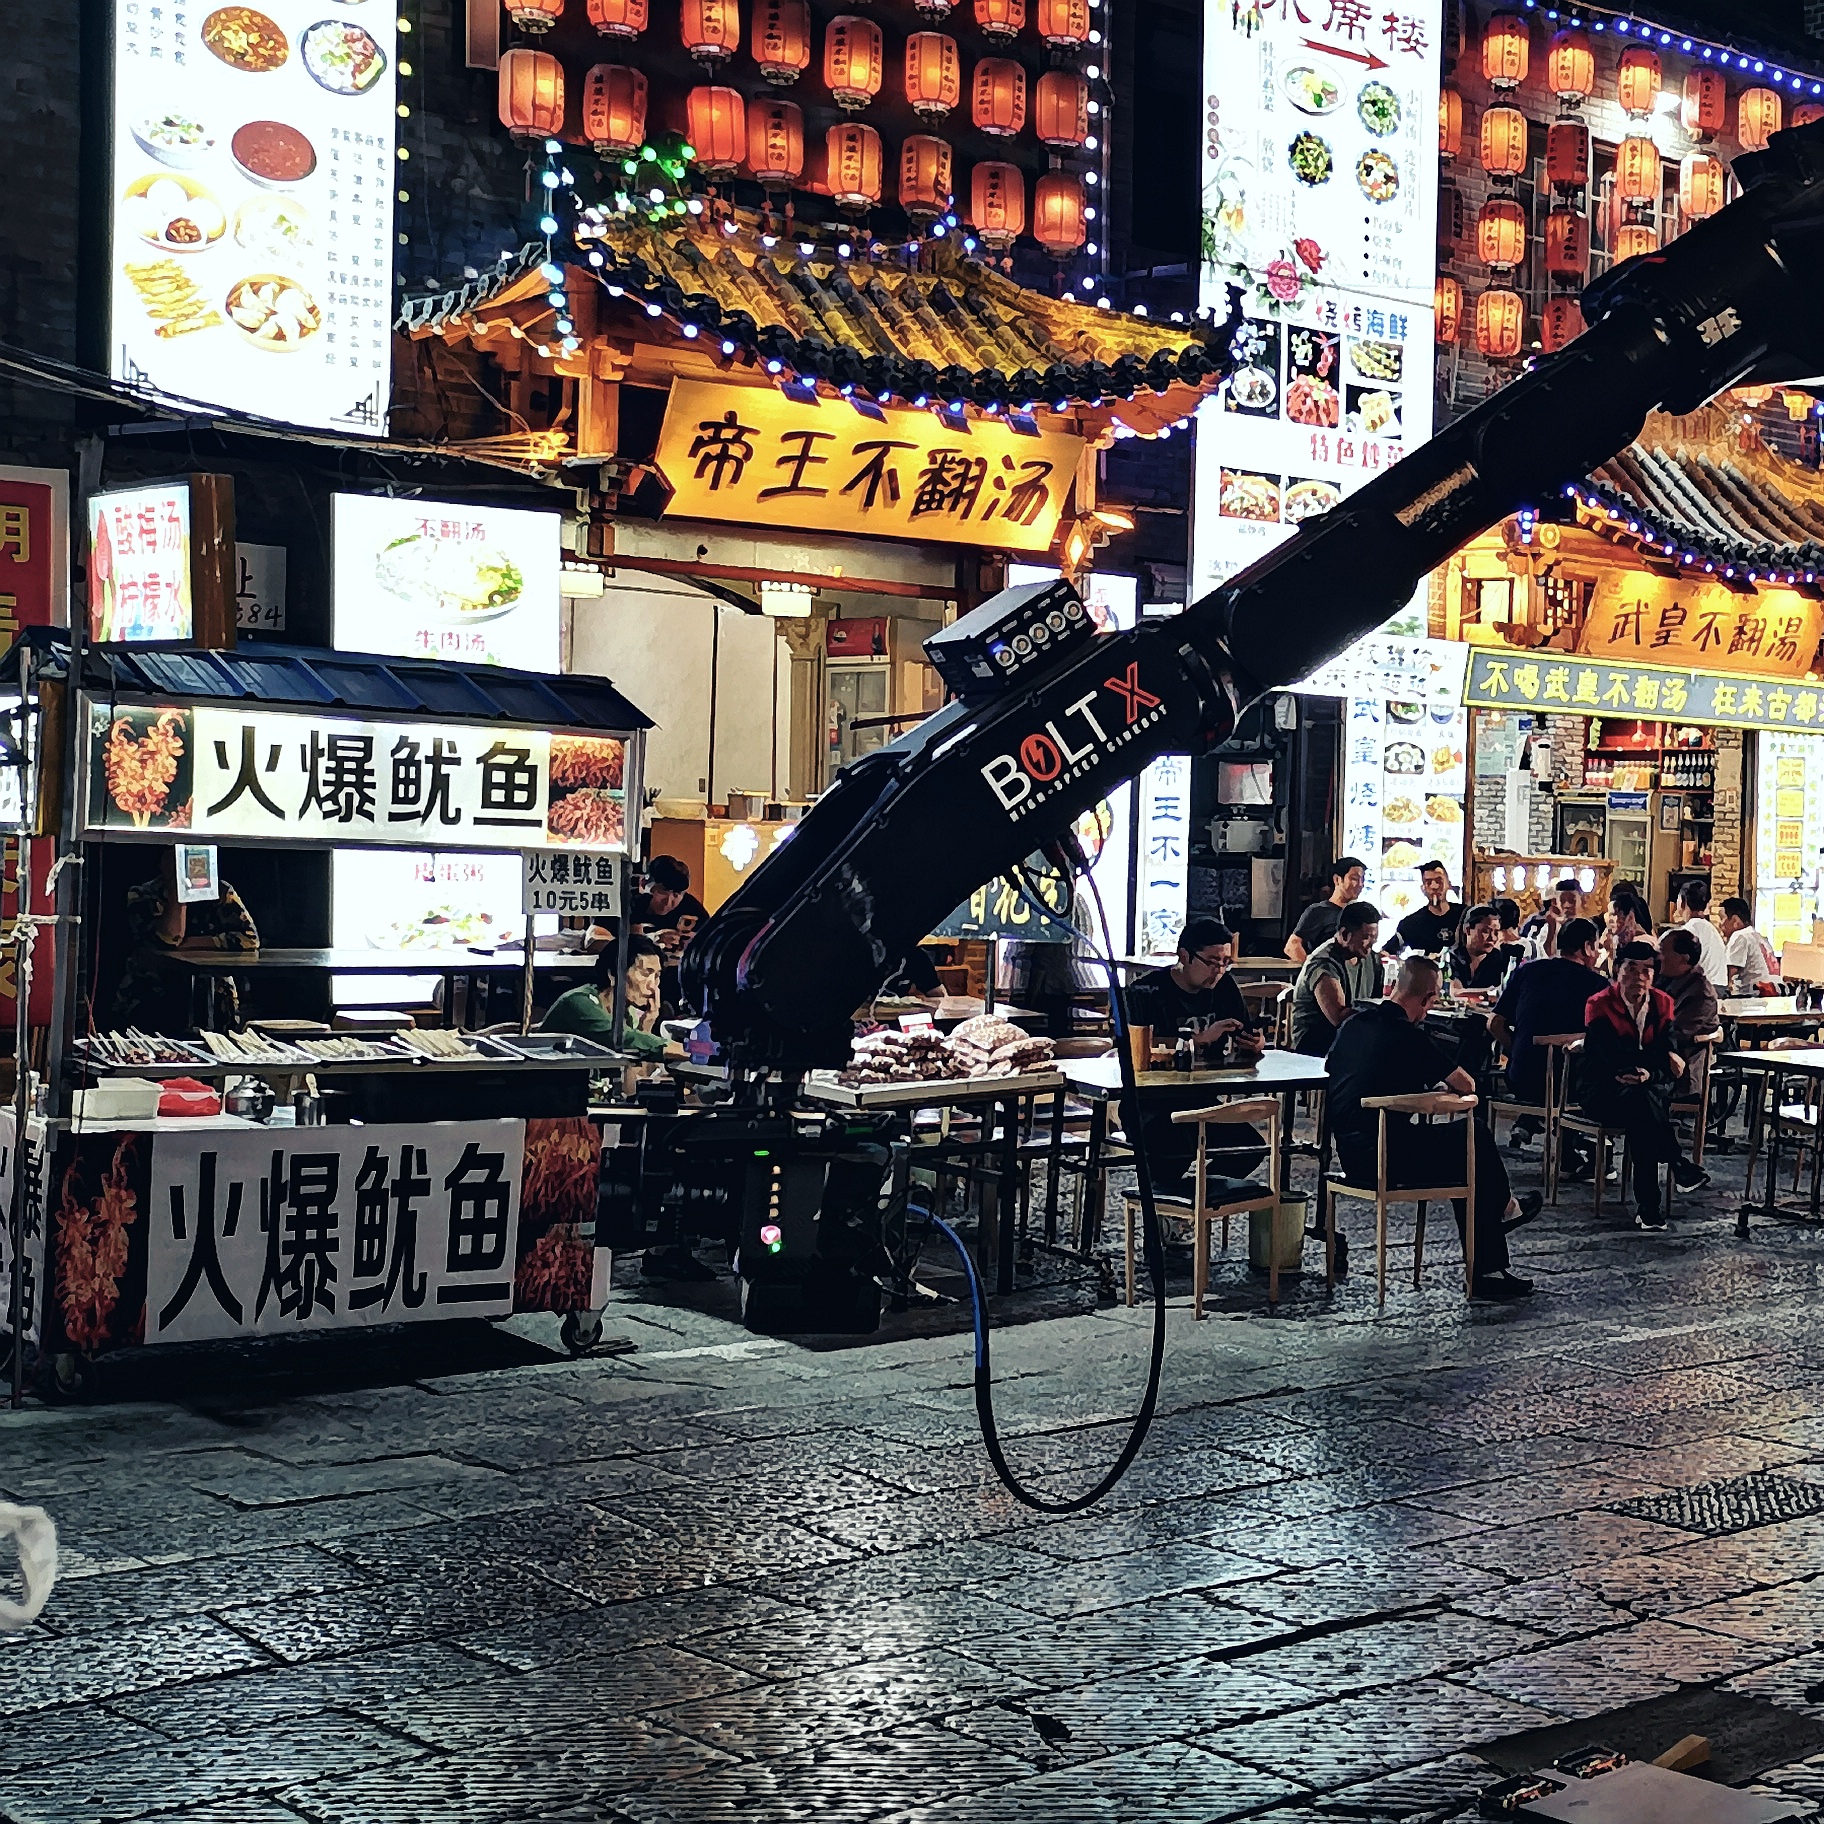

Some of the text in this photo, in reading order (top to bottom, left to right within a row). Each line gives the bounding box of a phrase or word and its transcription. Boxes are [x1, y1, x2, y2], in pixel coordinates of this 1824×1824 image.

[1316, 299, 1408, 341] 烧烤海鲜
[689, 411, 1054, 526] 帝王不翻汤
[115, 501, 182, 554] 酸梅汤
[415, 518, 486, 541] 不翻汤
[119, 570, 184, 623] 柠檬水
[415, 630, 486, 651] 牛肉汤
[1479, 661, 1690, 714] 不喝武皇不翻汤
[981, 661, 1161, 811] BOLT X
[206, 725, 545, 828] 火爆鱿鱼
[529, 853, 614, 885] 火爆鱿鱼
[533, 890, 611, 912] 10元5串
[158, 1142, 512, 1332] 火爆鱿鱼
